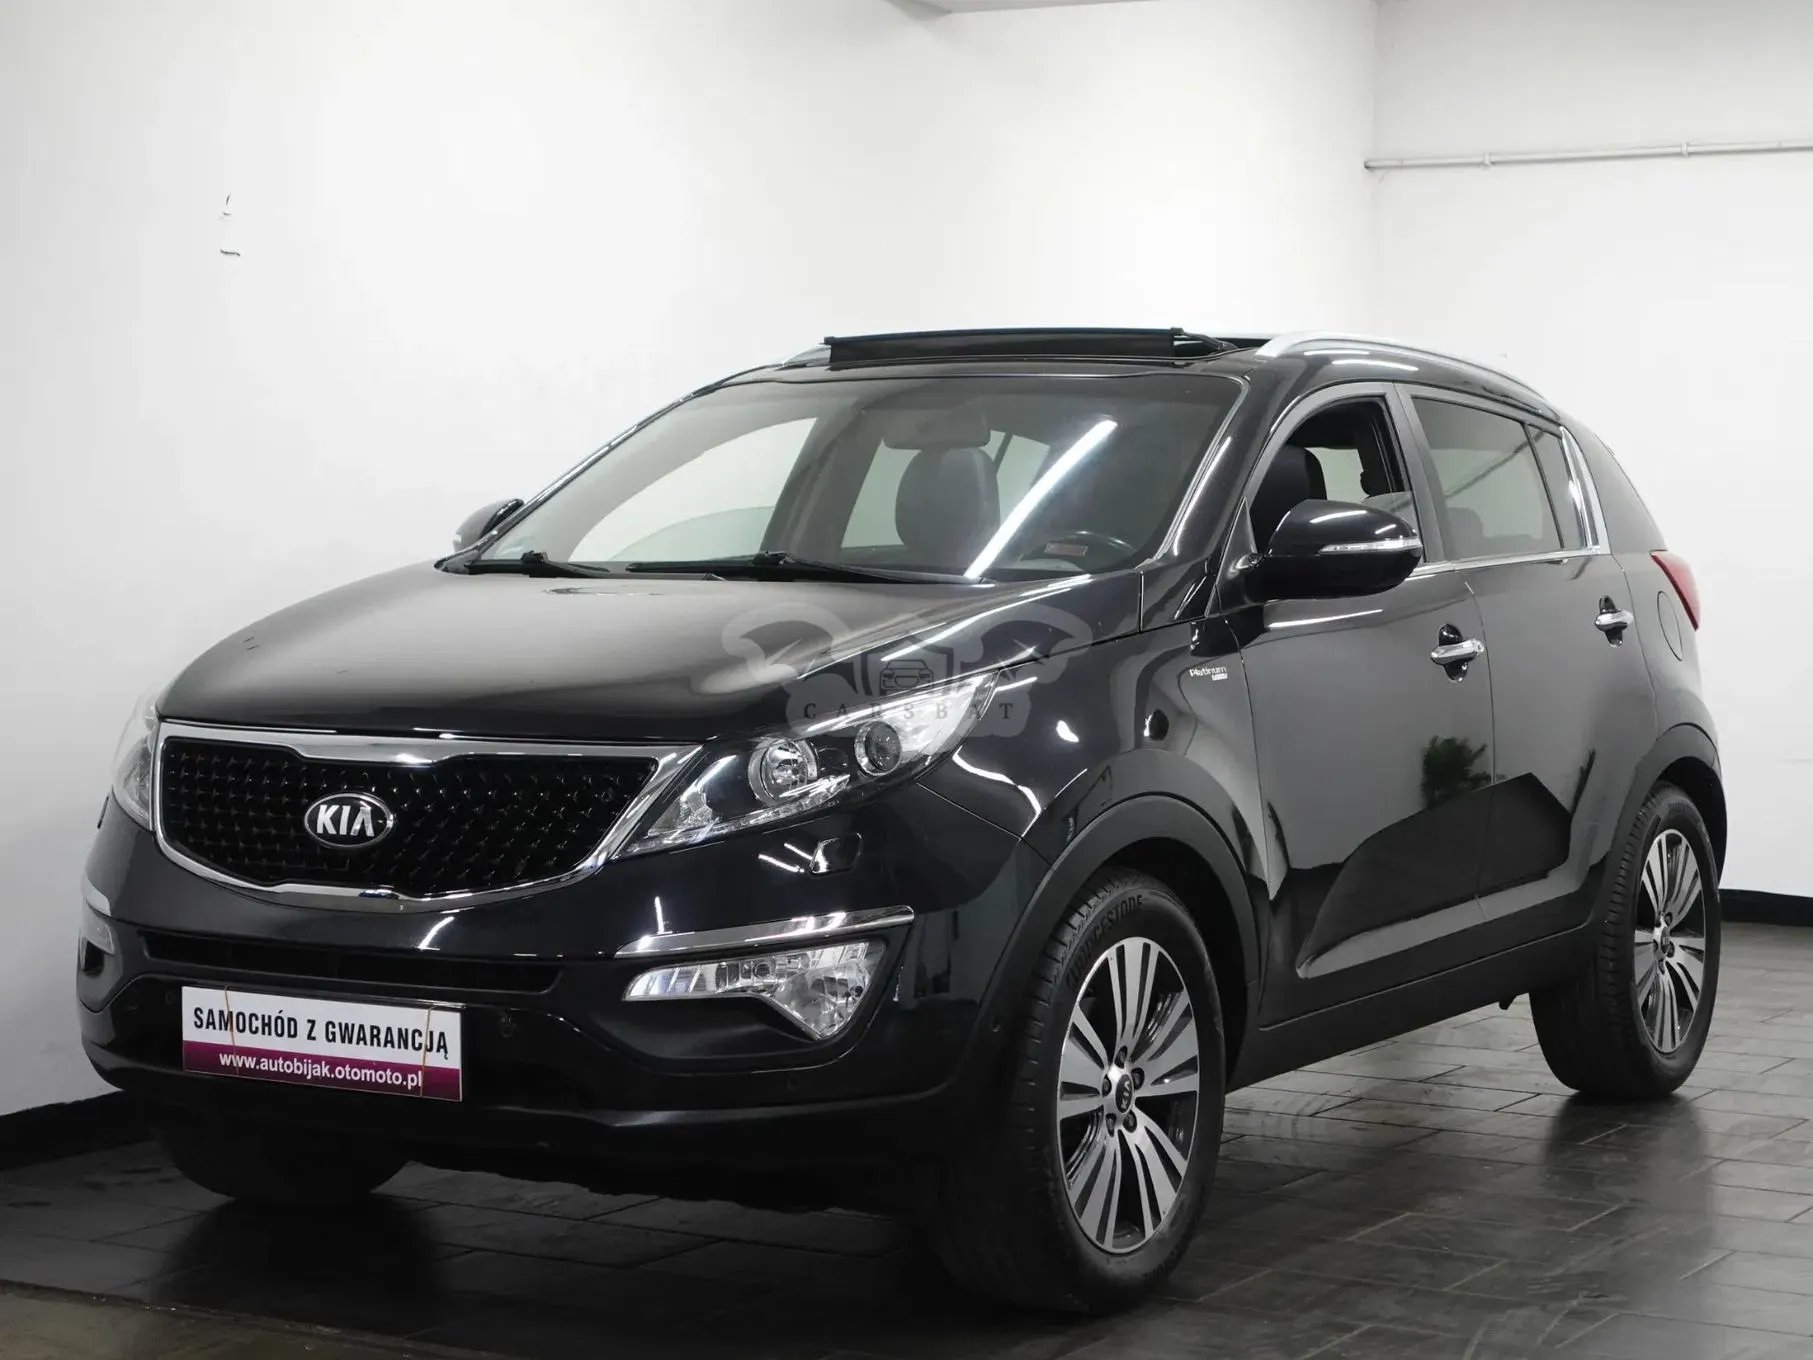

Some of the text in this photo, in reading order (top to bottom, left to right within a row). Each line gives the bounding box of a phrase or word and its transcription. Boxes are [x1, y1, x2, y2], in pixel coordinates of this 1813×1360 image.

[316, 803, 375, 837] KIA
[193, 1006, 450, 1060] SAMOCHÓD Z GWARANCJĄ
[218, 1051, 423, 1090] www.autobijak.otomoto.pl
